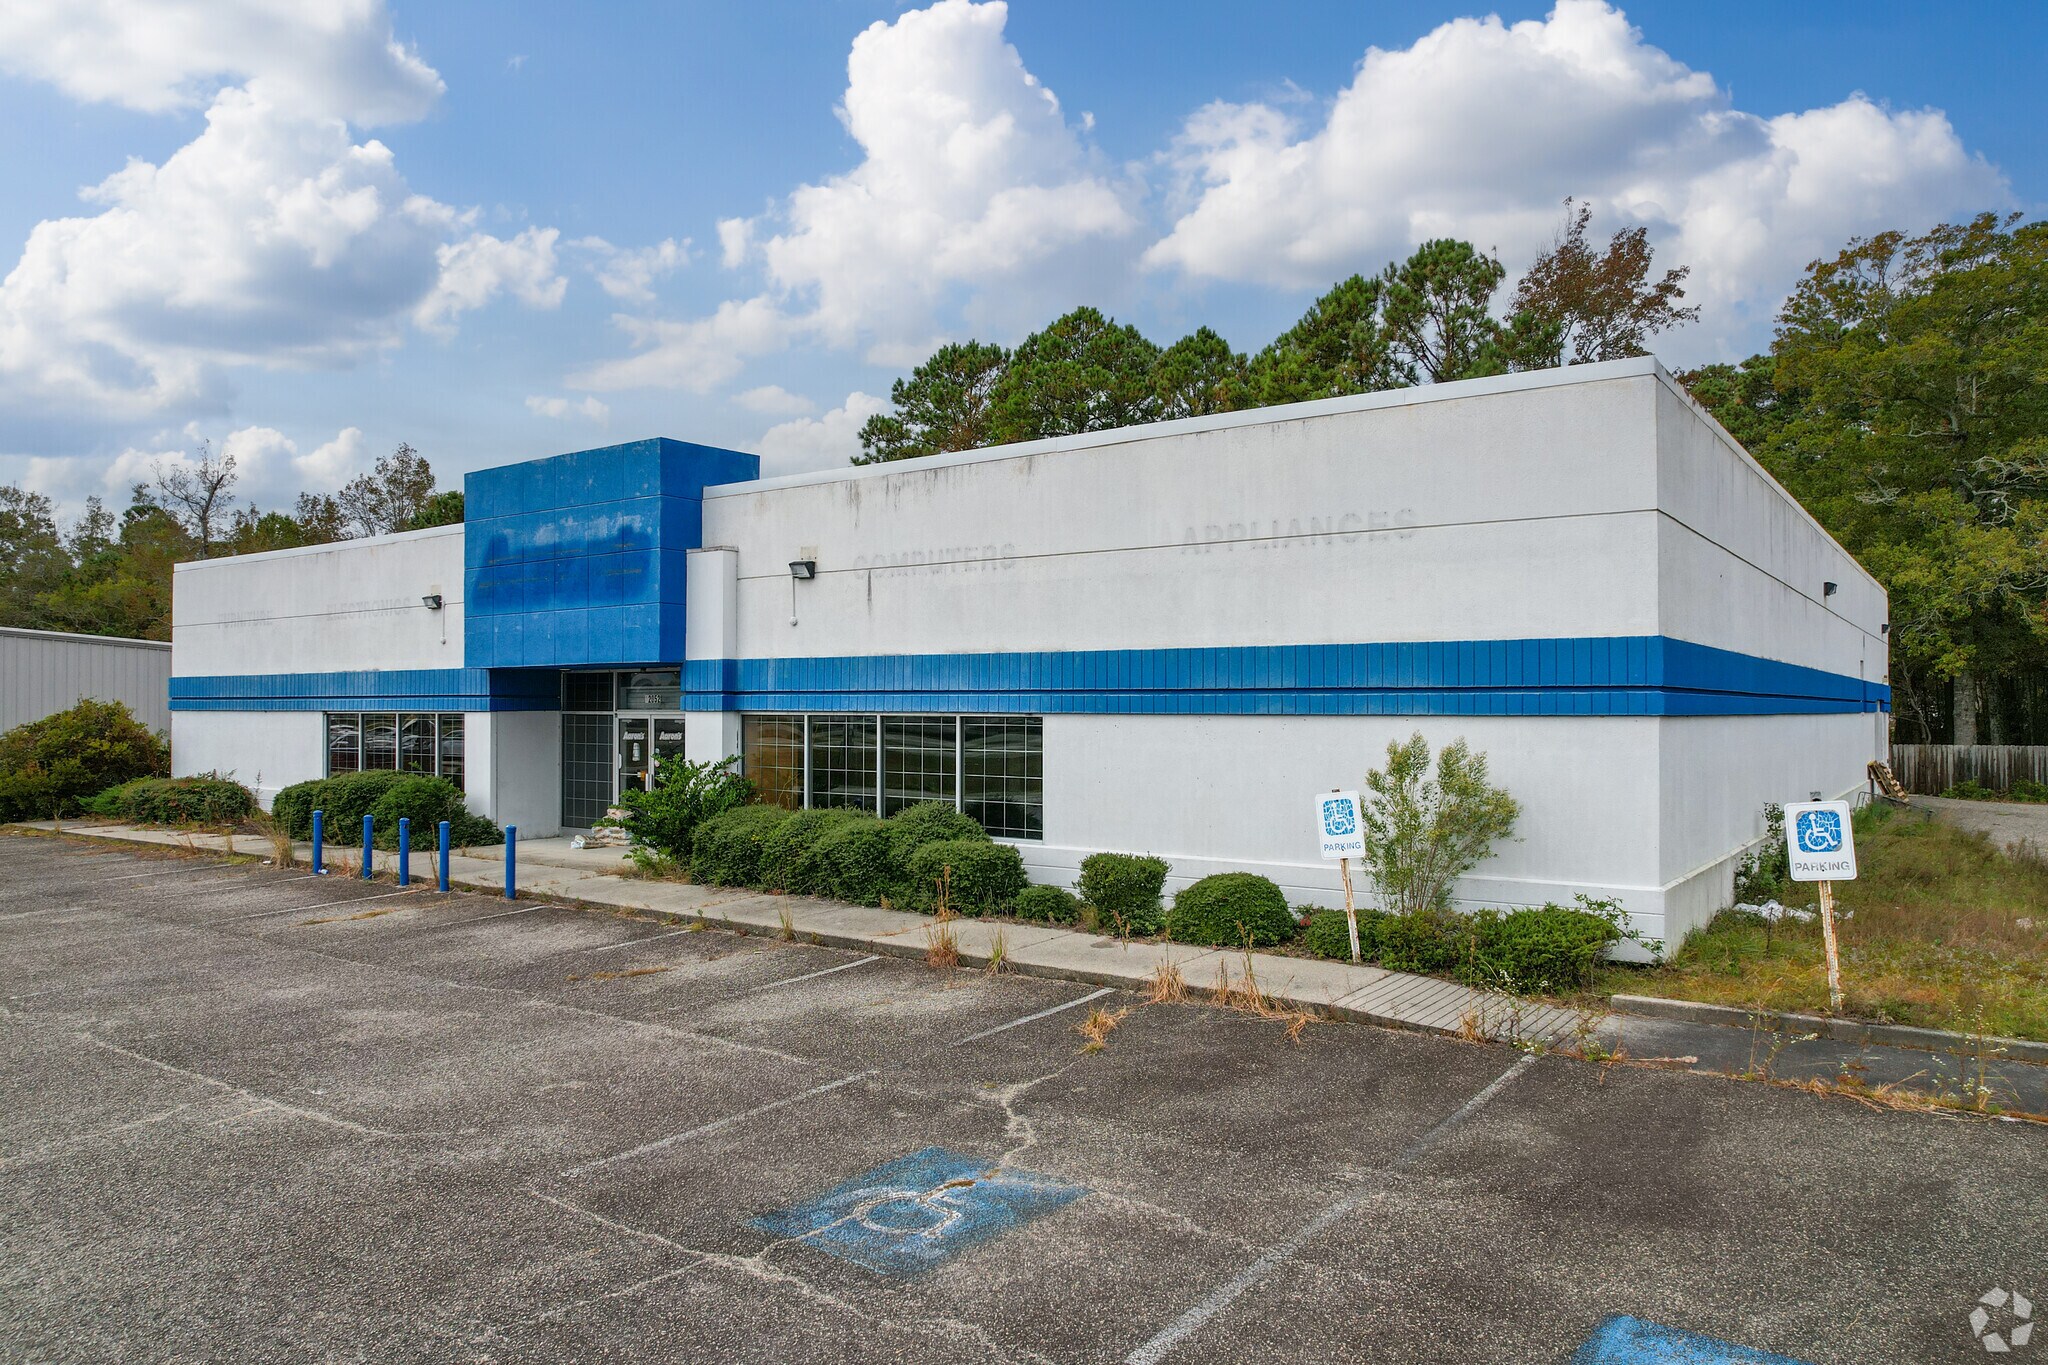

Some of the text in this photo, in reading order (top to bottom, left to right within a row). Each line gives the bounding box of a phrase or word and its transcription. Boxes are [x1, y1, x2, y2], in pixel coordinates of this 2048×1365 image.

[1180, 507, 1417, 555] APPLIANCES
[853, 543, 1016, 580] COMPUTERS
[1323, 841, 1361, 851] PARKING
[1794, 861, 1850, 872] PARKING
